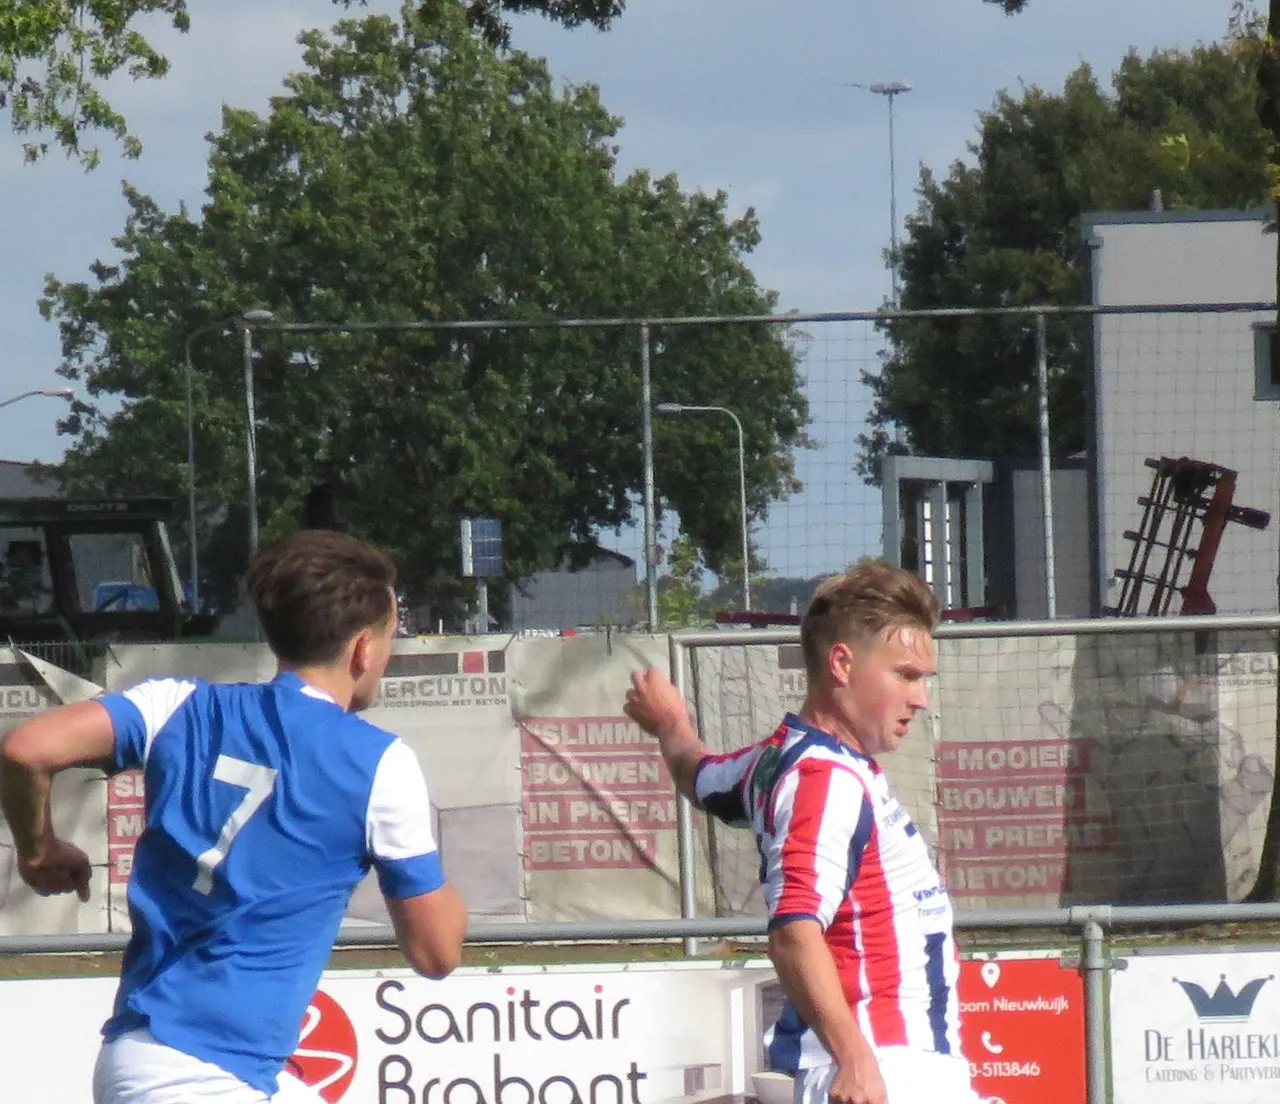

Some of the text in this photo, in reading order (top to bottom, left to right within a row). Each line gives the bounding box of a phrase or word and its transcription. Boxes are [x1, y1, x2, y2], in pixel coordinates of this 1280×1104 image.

[942, 784, 1075, 811] BOUWEN
[192, 754, 277, 896] 7
[529, 802, 559, 824] IN
[373, 979, 631, 1046] Sanitair
[994, 995, 1069, 1016] Nieuwkuijk
[968, 1061, 1041, 1078] 3-5113846
